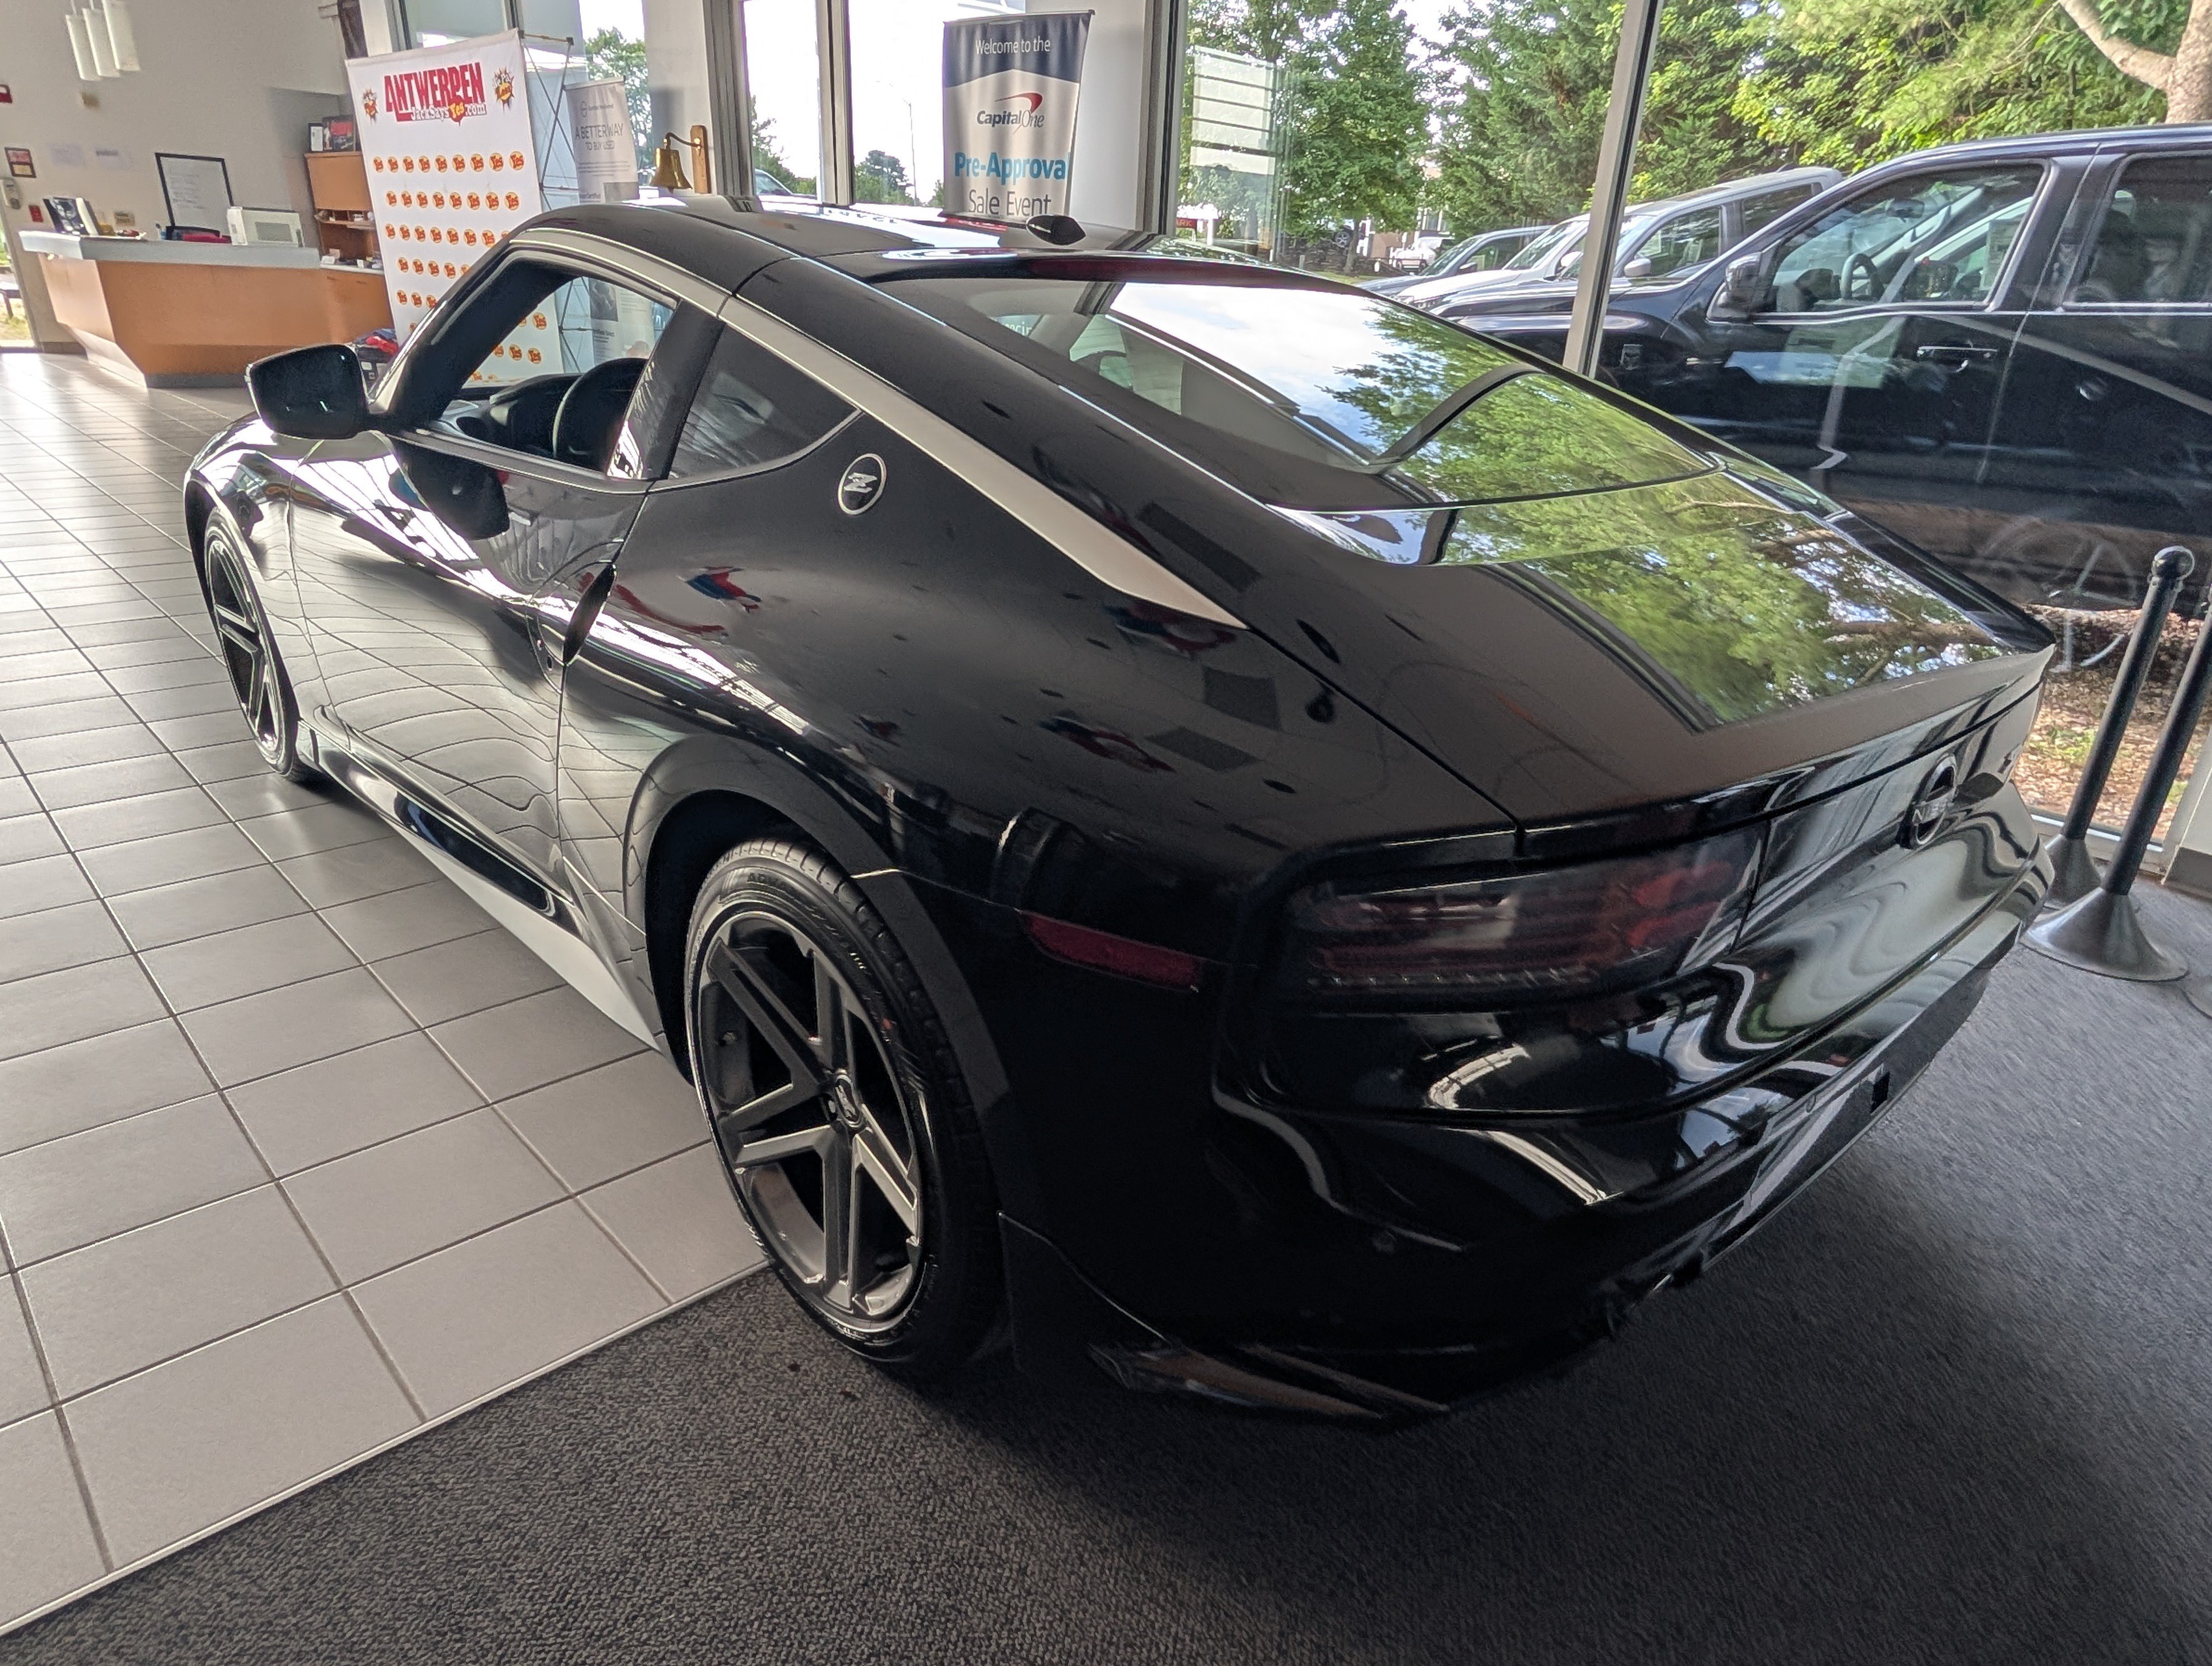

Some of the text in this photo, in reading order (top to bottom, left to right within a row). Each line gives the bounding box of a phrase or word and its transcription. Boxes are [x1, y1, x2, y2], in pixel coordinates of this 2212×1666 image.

[975, 35, 1051, 55] Welcome to the
[384, 62, 485, 112] ANTWERPEN
[581, 124, 607, 140] BETTER
[607, 123, 623, 137] WAY
[968, 188, 1052, 216] Sale Event
